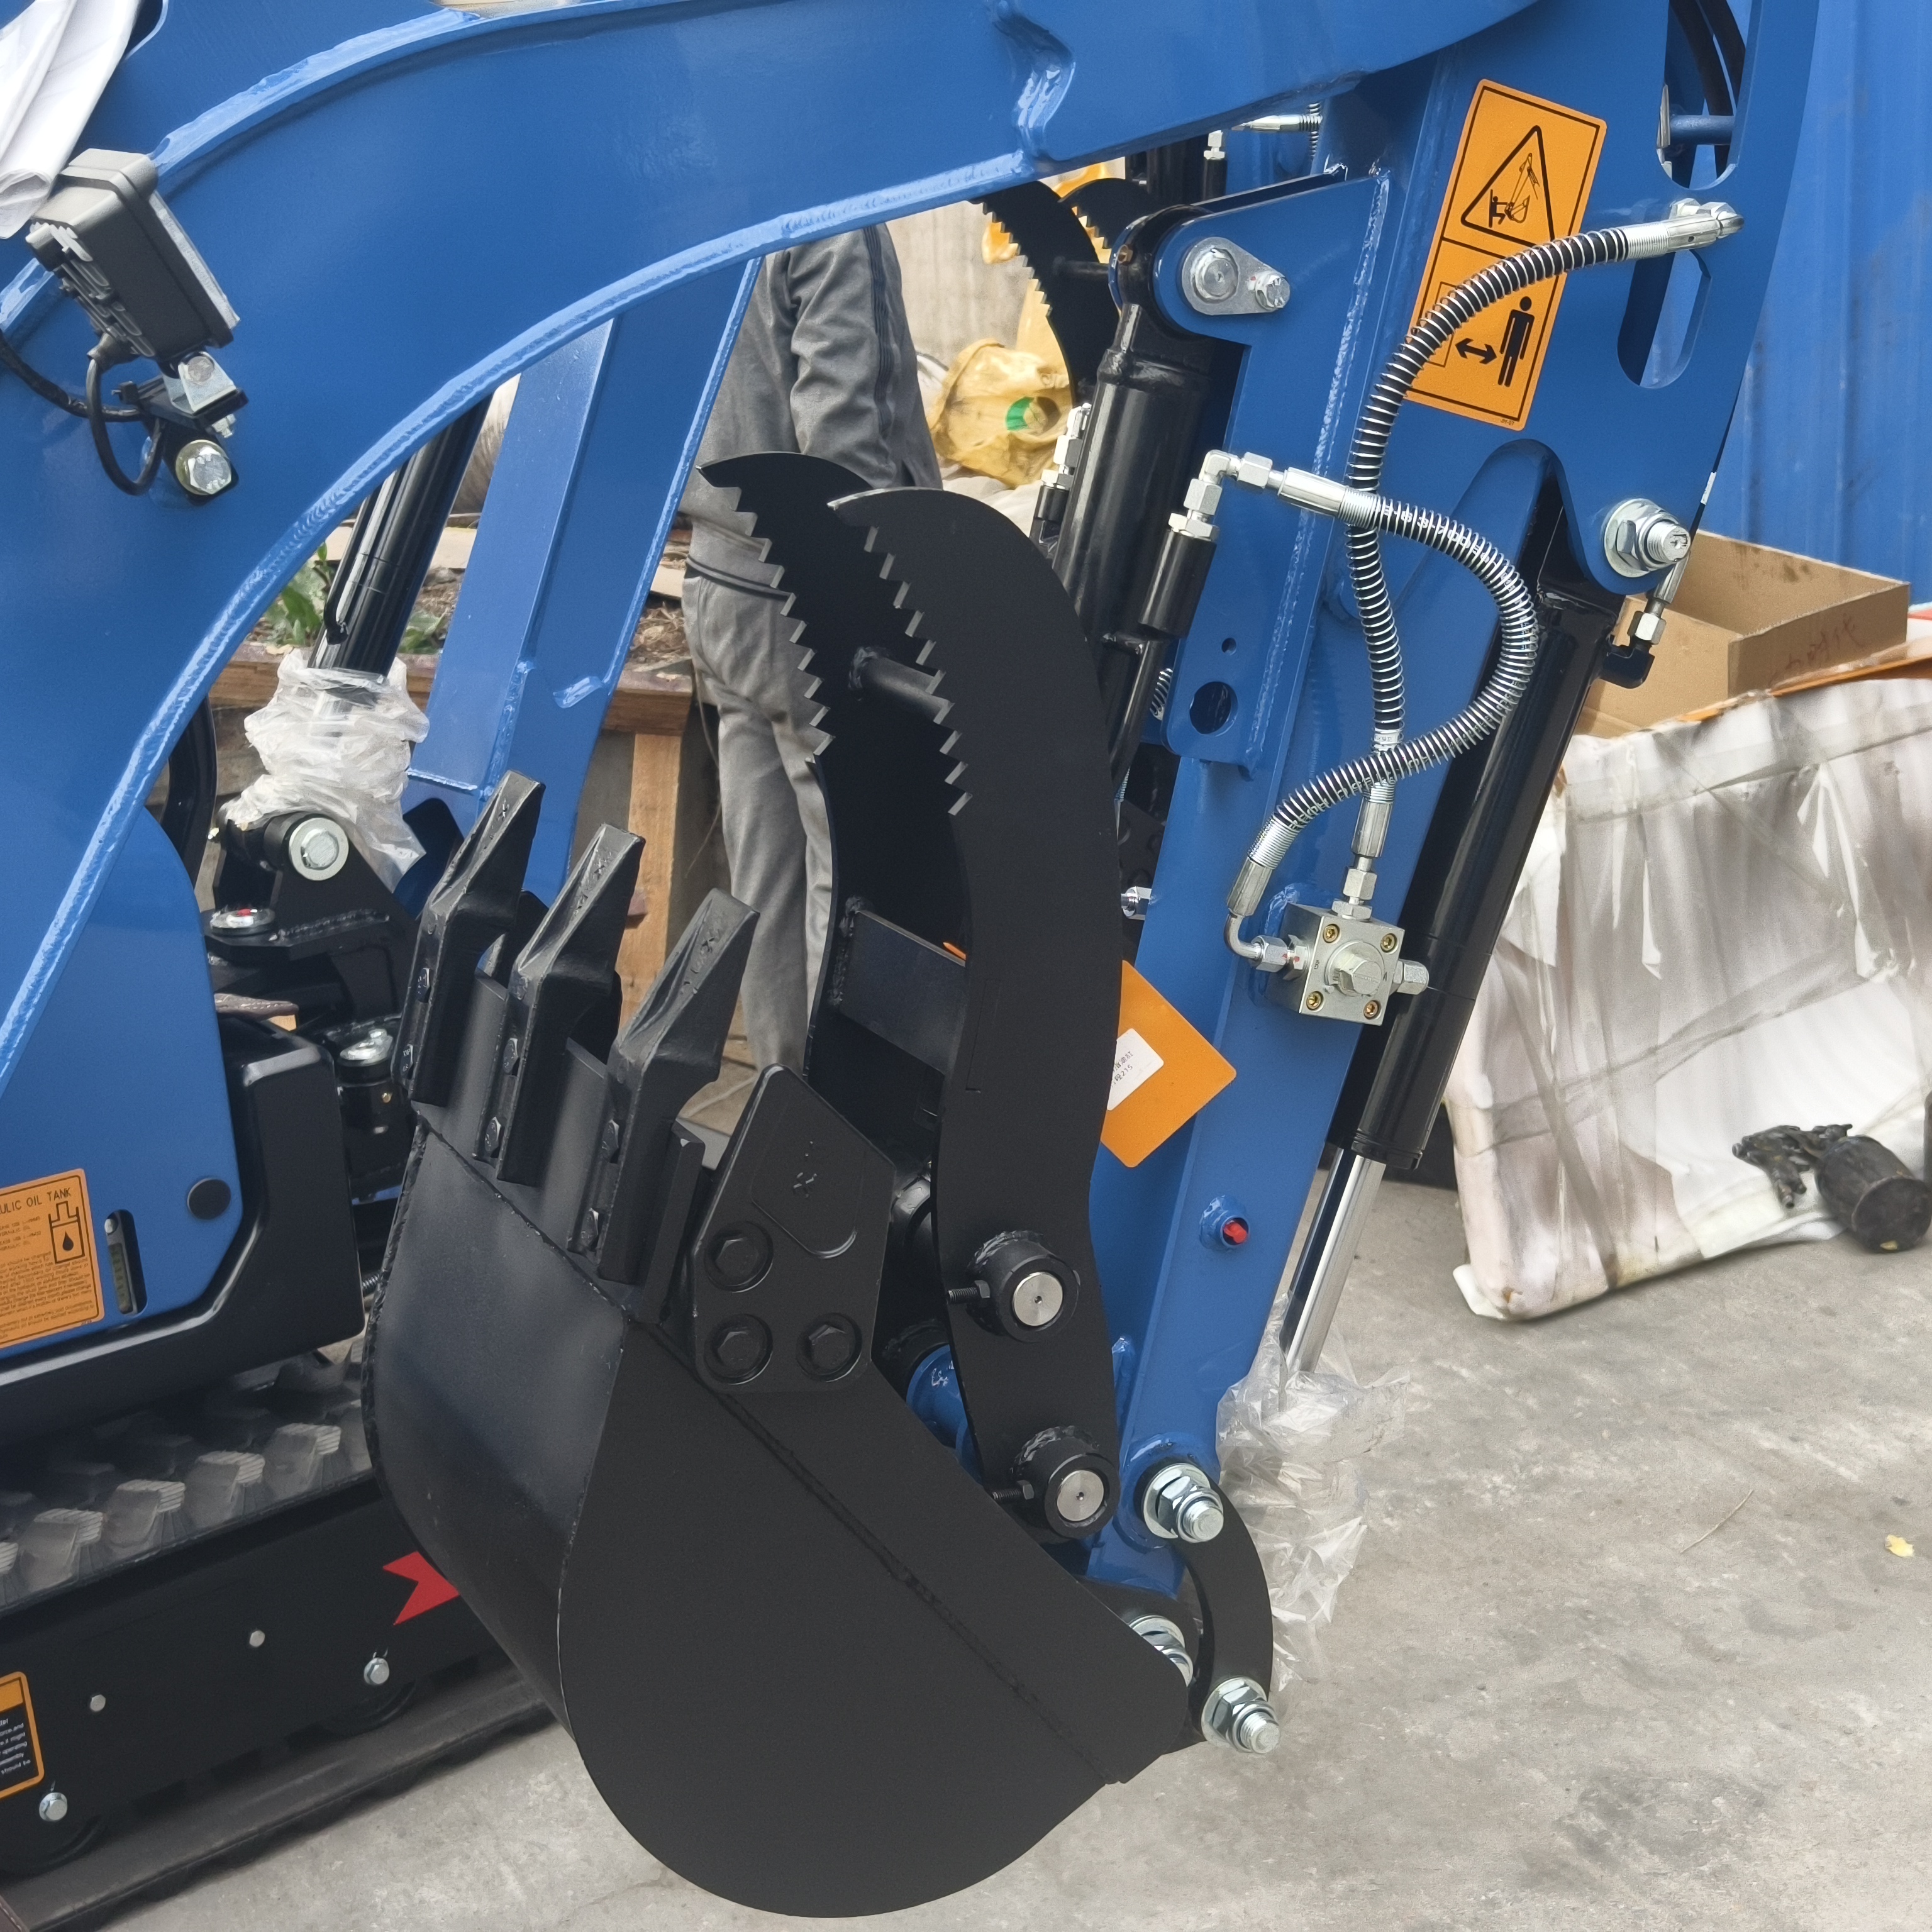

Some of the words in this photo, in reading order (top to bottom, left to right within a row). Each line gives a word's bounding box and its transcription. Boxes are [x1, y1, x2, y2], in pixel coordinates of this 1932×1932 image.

[0, 1200, 22, 1214] ULIC
[26, 1195, 43, 1207] OIL
[47, 1187, 71, 1201] TANK
